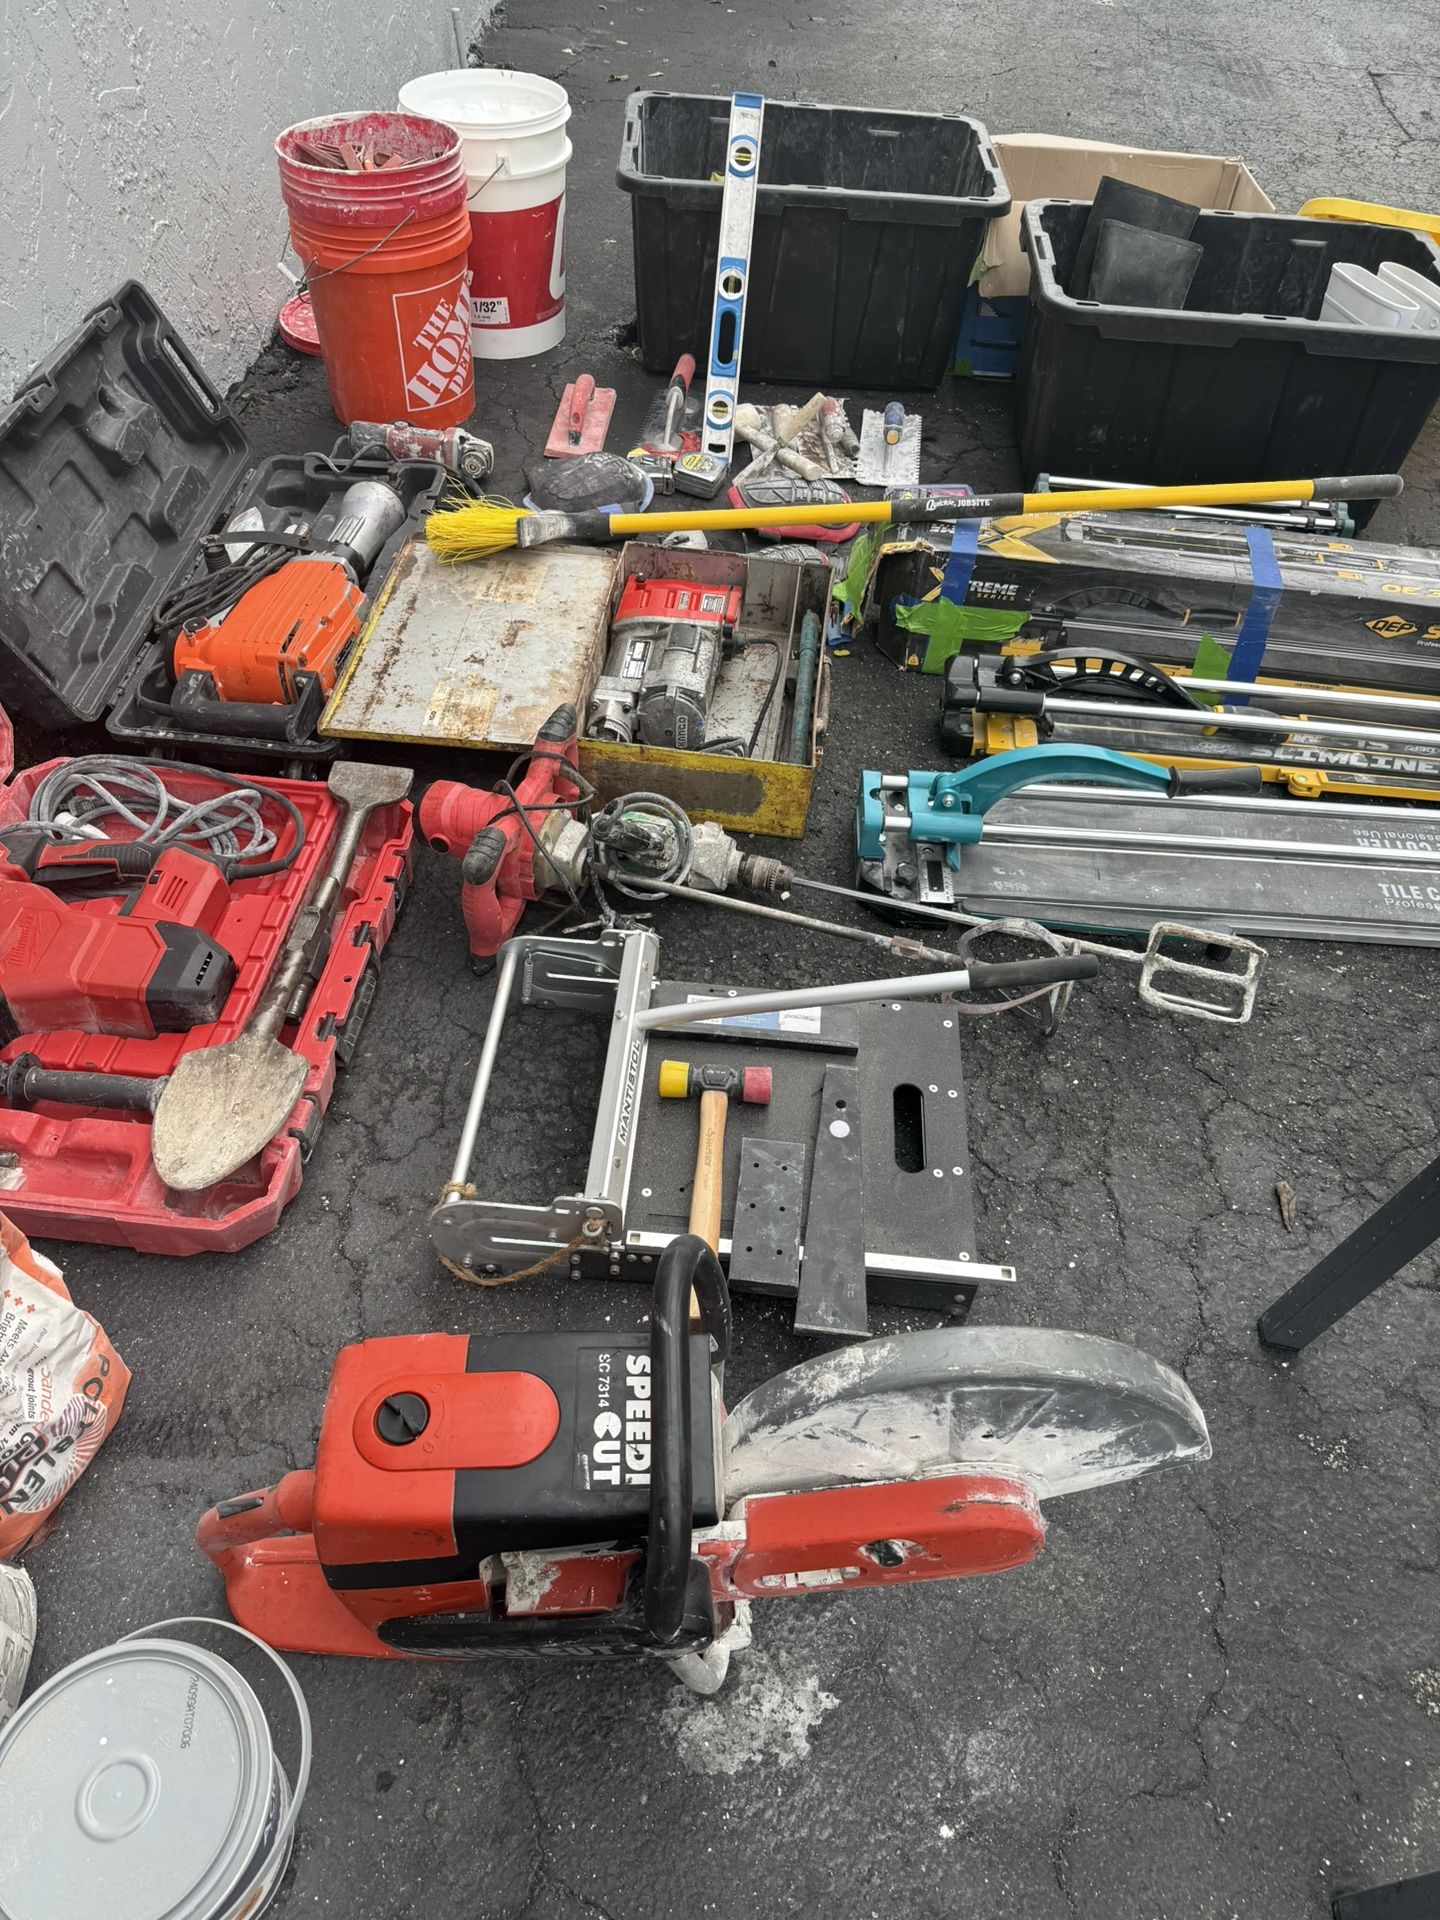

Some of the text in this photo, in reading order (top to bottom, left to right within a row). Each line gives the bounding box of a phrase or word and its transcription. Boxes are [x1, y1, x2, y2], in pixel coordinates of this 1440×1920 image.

[472, 300, 502, 313] 1/32"
[412, 297, 454, 351] THE
[925, 498, 991, 511] Quickie JOBSITE
[976, 593, 1016, 602] SERIES
[1371, 620, 1414, 633] QEP
[1250, 745, 1440, 775] SLIMLINE
[1377, 883, 1424, 900] TILE
[618, 1040, 642, 1147] MANTISTOL
[6, 1318, 28, 1349] Meets
[26, 1367, 37, 1419] grout joints
[597, 1353, 611, 1408] SC 7314
[625, 1354, 652, 1485] SPEEDI
[592, 1411, 622, 1486] CUT
